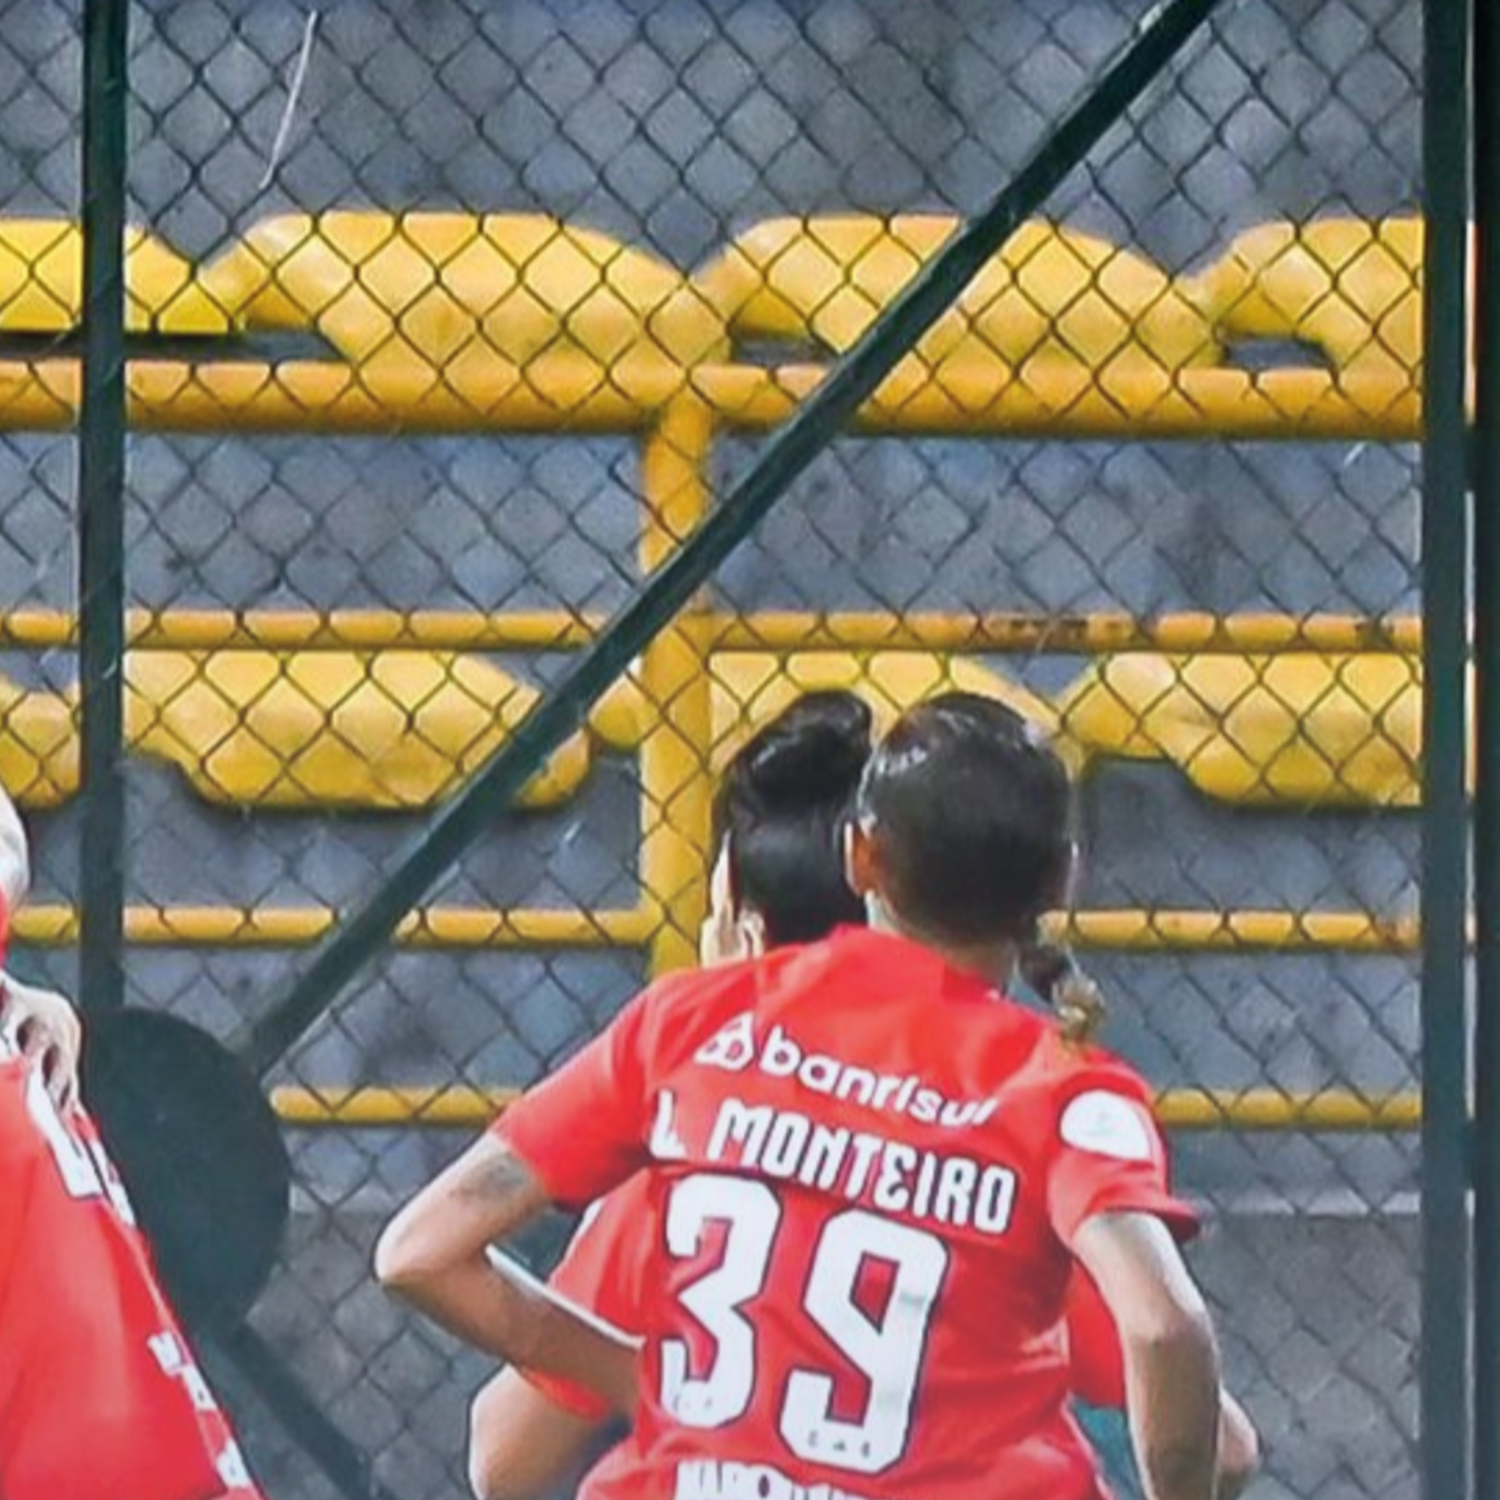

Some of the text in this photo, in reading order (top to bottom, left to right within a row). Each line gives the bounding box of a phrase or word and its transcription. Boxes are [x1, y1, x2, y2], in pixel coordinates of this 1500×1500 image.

[759, 1024, 1000, 1128] banrisul
[706, 1097, 1017, 1235] MONTEIRO
[659, 1173, 950, 1474] 39
